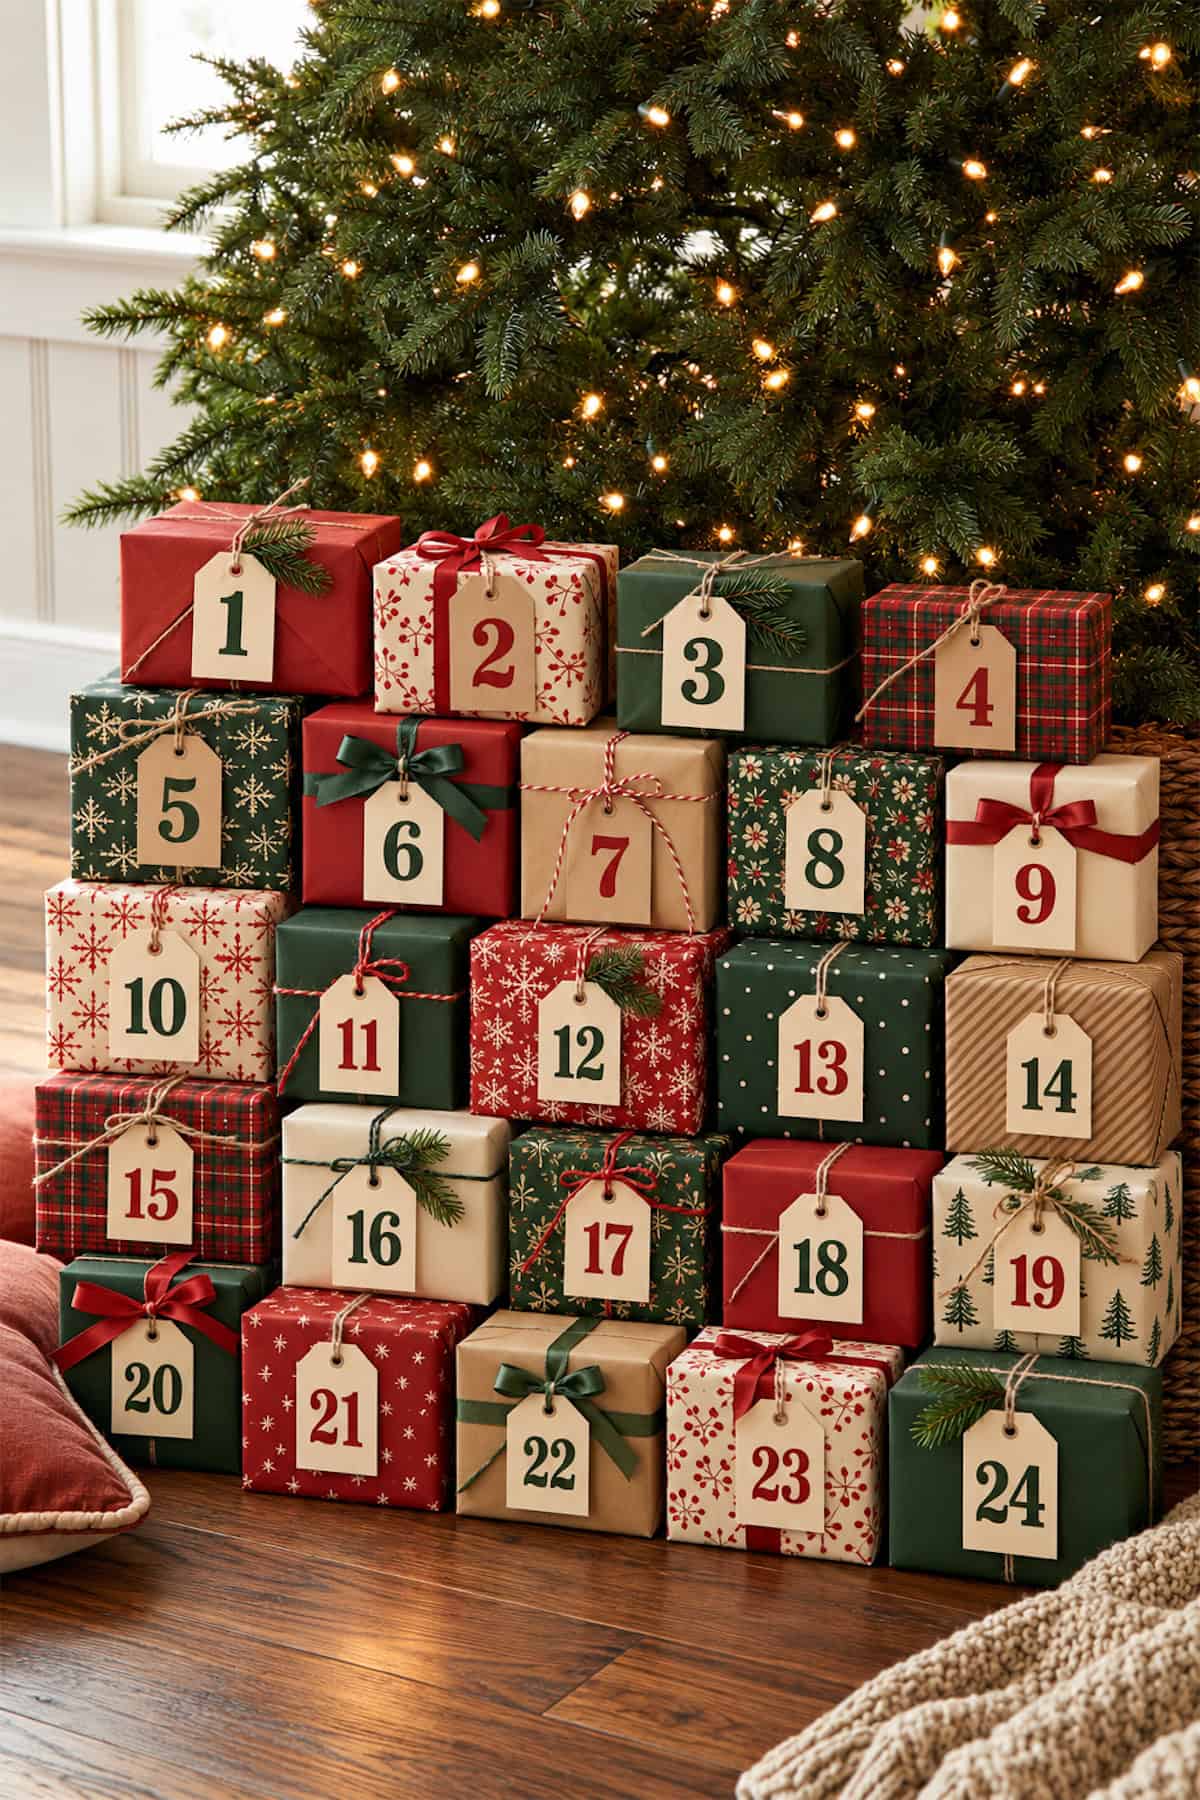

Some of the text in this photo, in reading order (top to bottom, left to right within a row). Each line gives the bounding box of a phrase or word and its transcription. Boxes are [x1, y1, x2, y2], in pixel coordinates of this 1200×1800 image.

[218, 590, 249, 657] 1
[471, 617, 515, 689] 2
[680, 636, 726, 706] 3
[955, 666, 994, 727] 4
[157, 776, 200, 844] 5
[383, 820, 424, 882] 6
[591, 834, 630, 898] 7
[804, 827, 845, 890] 8
[1015, 863, 1057, 925] 9
[124, 977, 187, 1037] 10
[336, 1017, 382, 1072] 11
[553, 1024, 605, 1081] 12
[793, 1039, 849, 1096] 13
[1020, 1057, 1078, 1114] 14
[124, 1167, 179, 1221] 15
[346, 1209, 402, 1267] 16
[583, 1221, 634, 1277] 17
[792, 1238, 849, 1297] 18
[1009, 1254, 1065, 1310] 19
[124, 1362, 183, 1416] 20
[309, 1388, 363, 1448] 21
[523, 1435, 576, 1491] 22
[751, 1445, 811, 1505] 23
[975, 1460, 1046, 1529] 24
